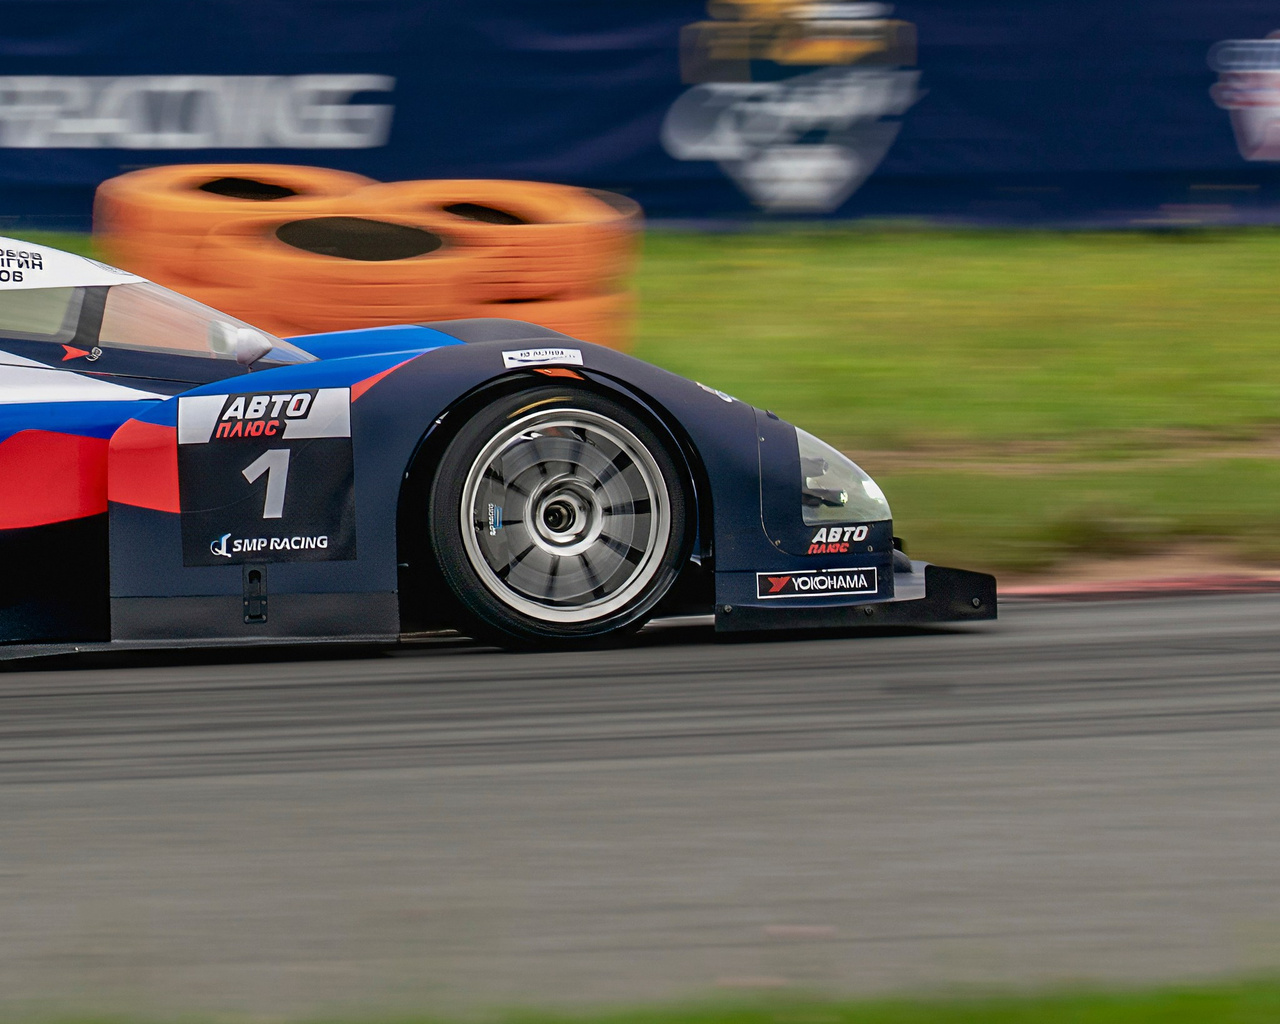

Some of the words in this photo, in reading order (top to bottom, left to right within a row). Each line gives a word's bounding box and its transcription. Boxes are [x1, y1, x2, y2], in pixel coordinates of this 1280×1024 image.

[222, 393, 312, 420] АВТО
[215, 420, 279, 438] ПЛЮС
[241, 448, 291, 519] 1
[811, 526, 869, 543] АВТО
[232, 538, 267, 552] SMP
[269, 535, 328, 550] RACING
[792, 574, 868, 591] YOKOHAMA
